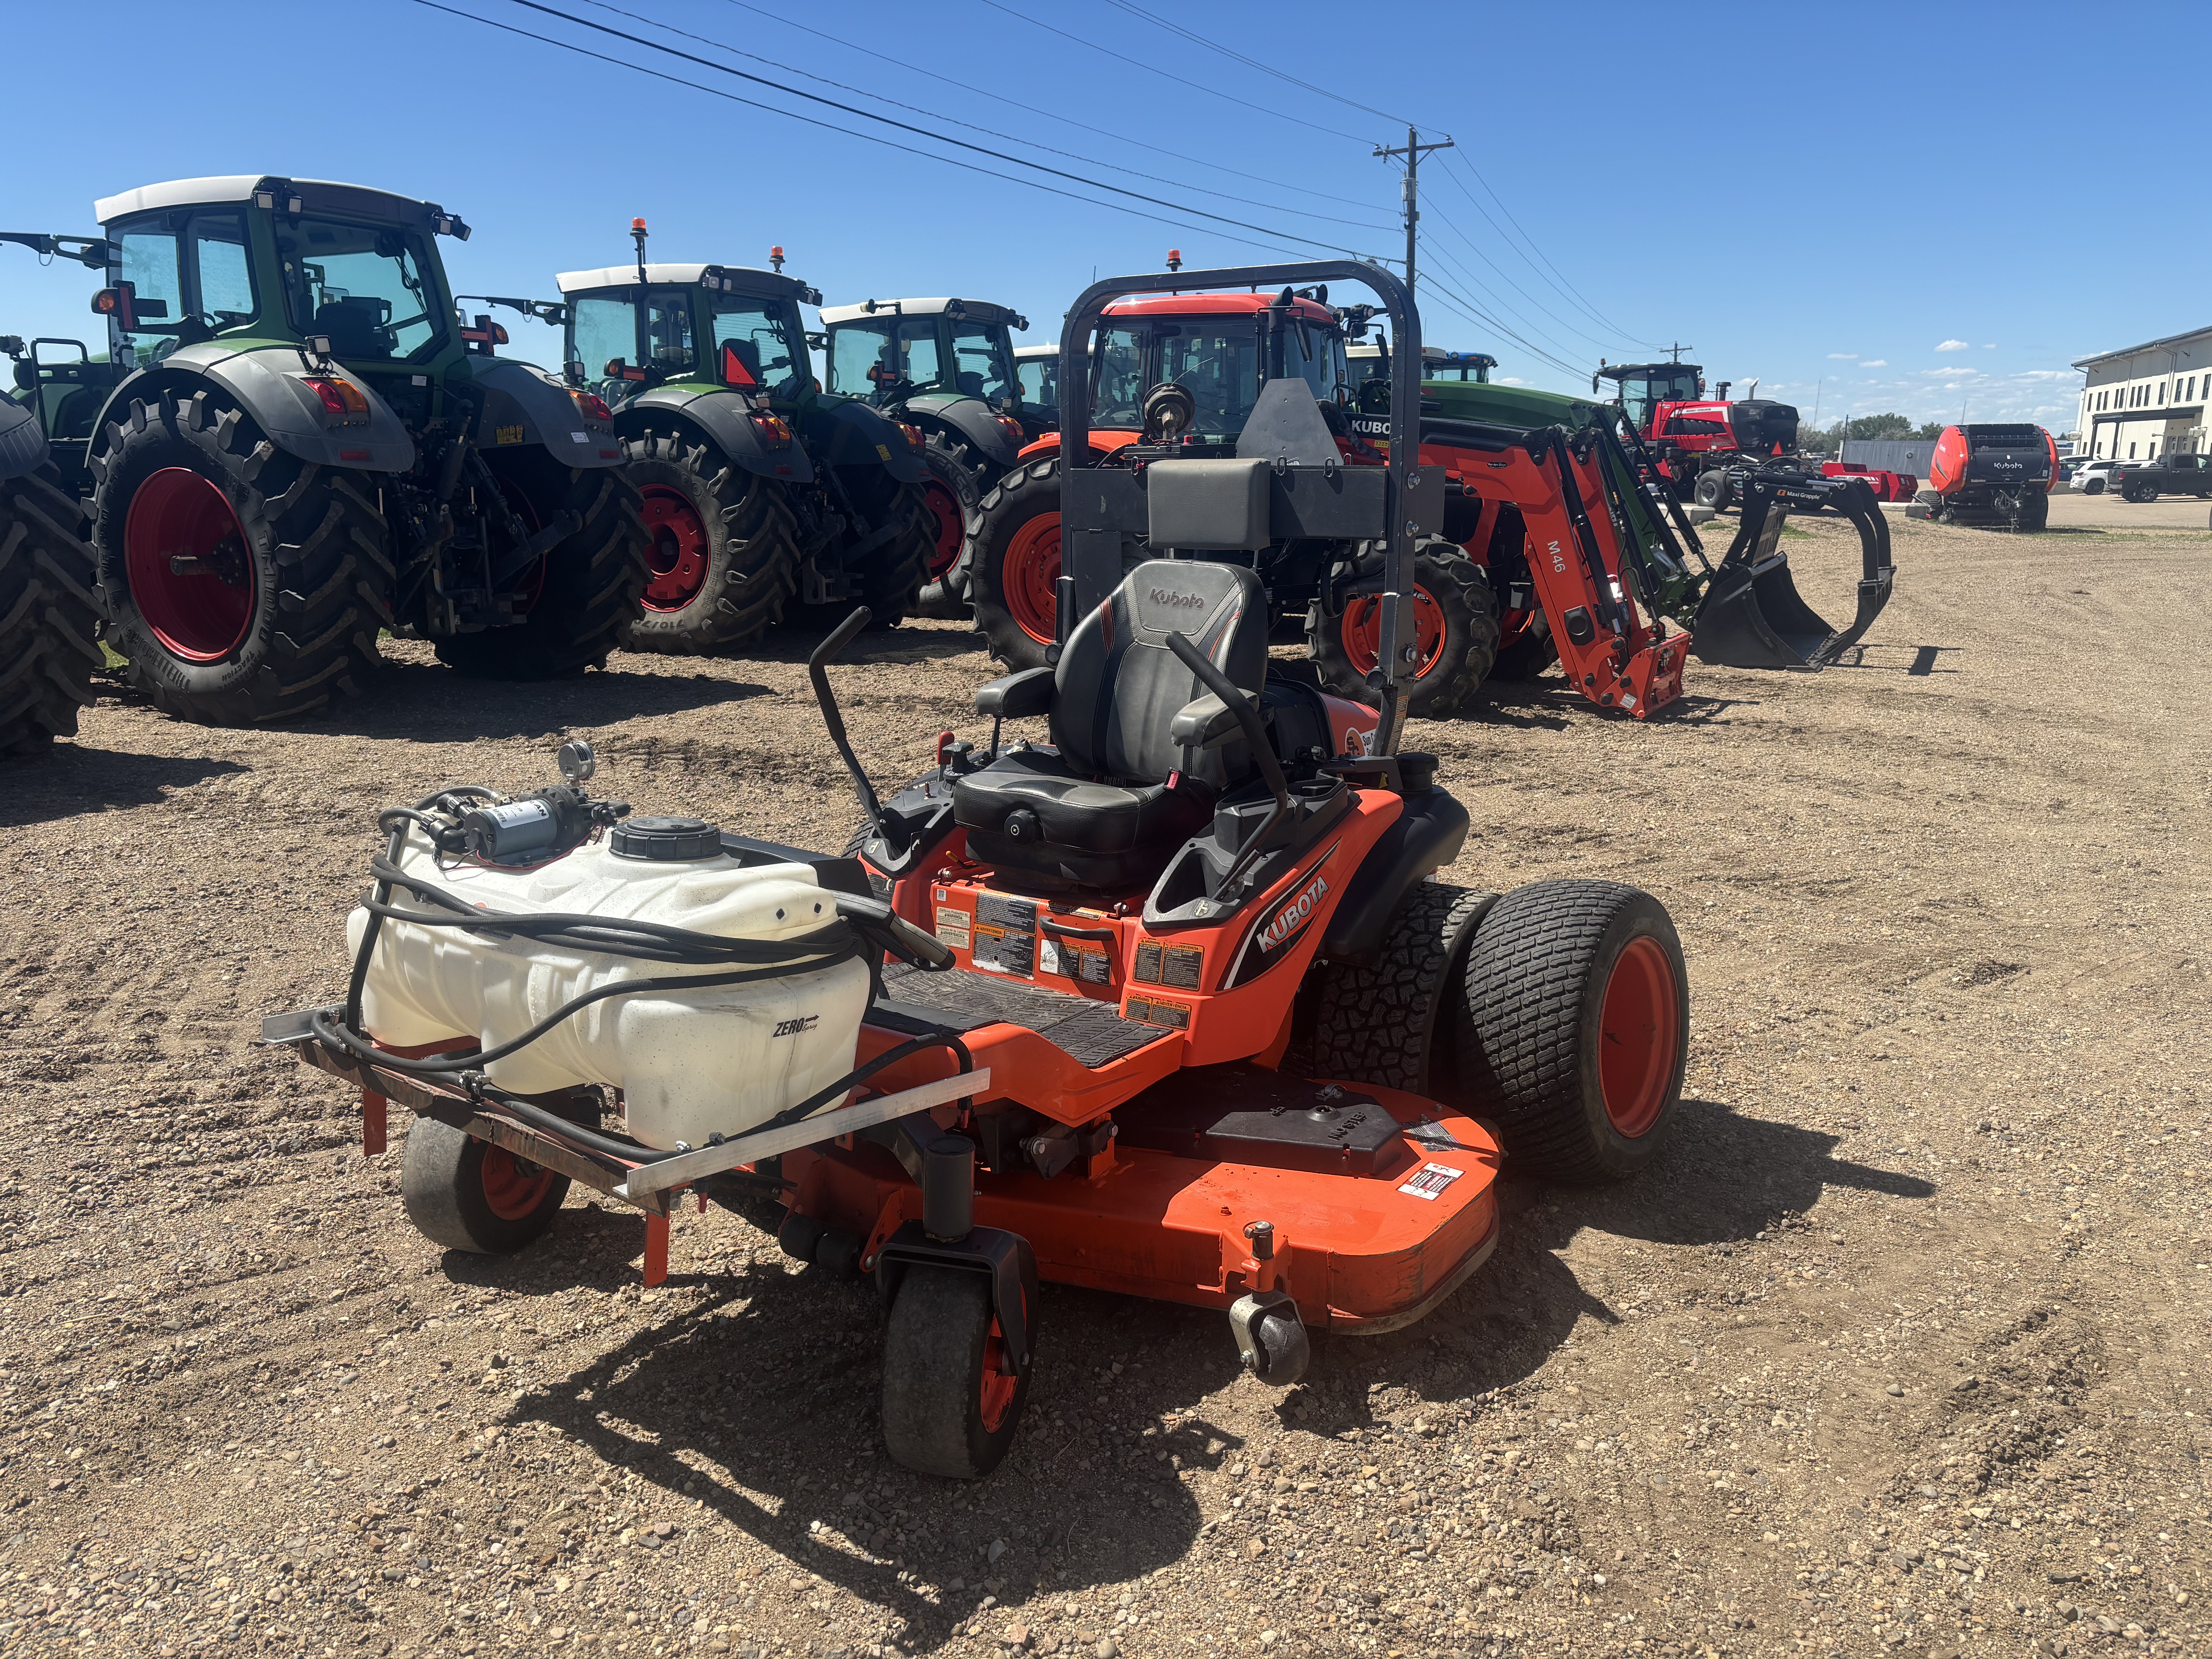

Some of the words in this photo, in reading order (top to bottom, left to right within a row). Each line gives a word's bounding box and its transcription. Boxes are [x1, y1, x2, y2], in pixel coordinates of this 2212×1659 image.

[701, 531, 724, 612] TRELLEBORG
[1547, 540, 1565, 573] M46
[258, 530, 276, 646] TM1000
[1150, 588, 1204, 609] Kubota
[124, 625, 191, 693] TRELLEBORG
[1362, 735, 1372, 747] Sun
[1256, 875, 1329, 953] KUBOTA
[1159, 1000, 1187, 1010] ADVERTENCIA
[773, 1017, 805, 1038] ZERO
[802, 1024, 817, 1033] Spray
